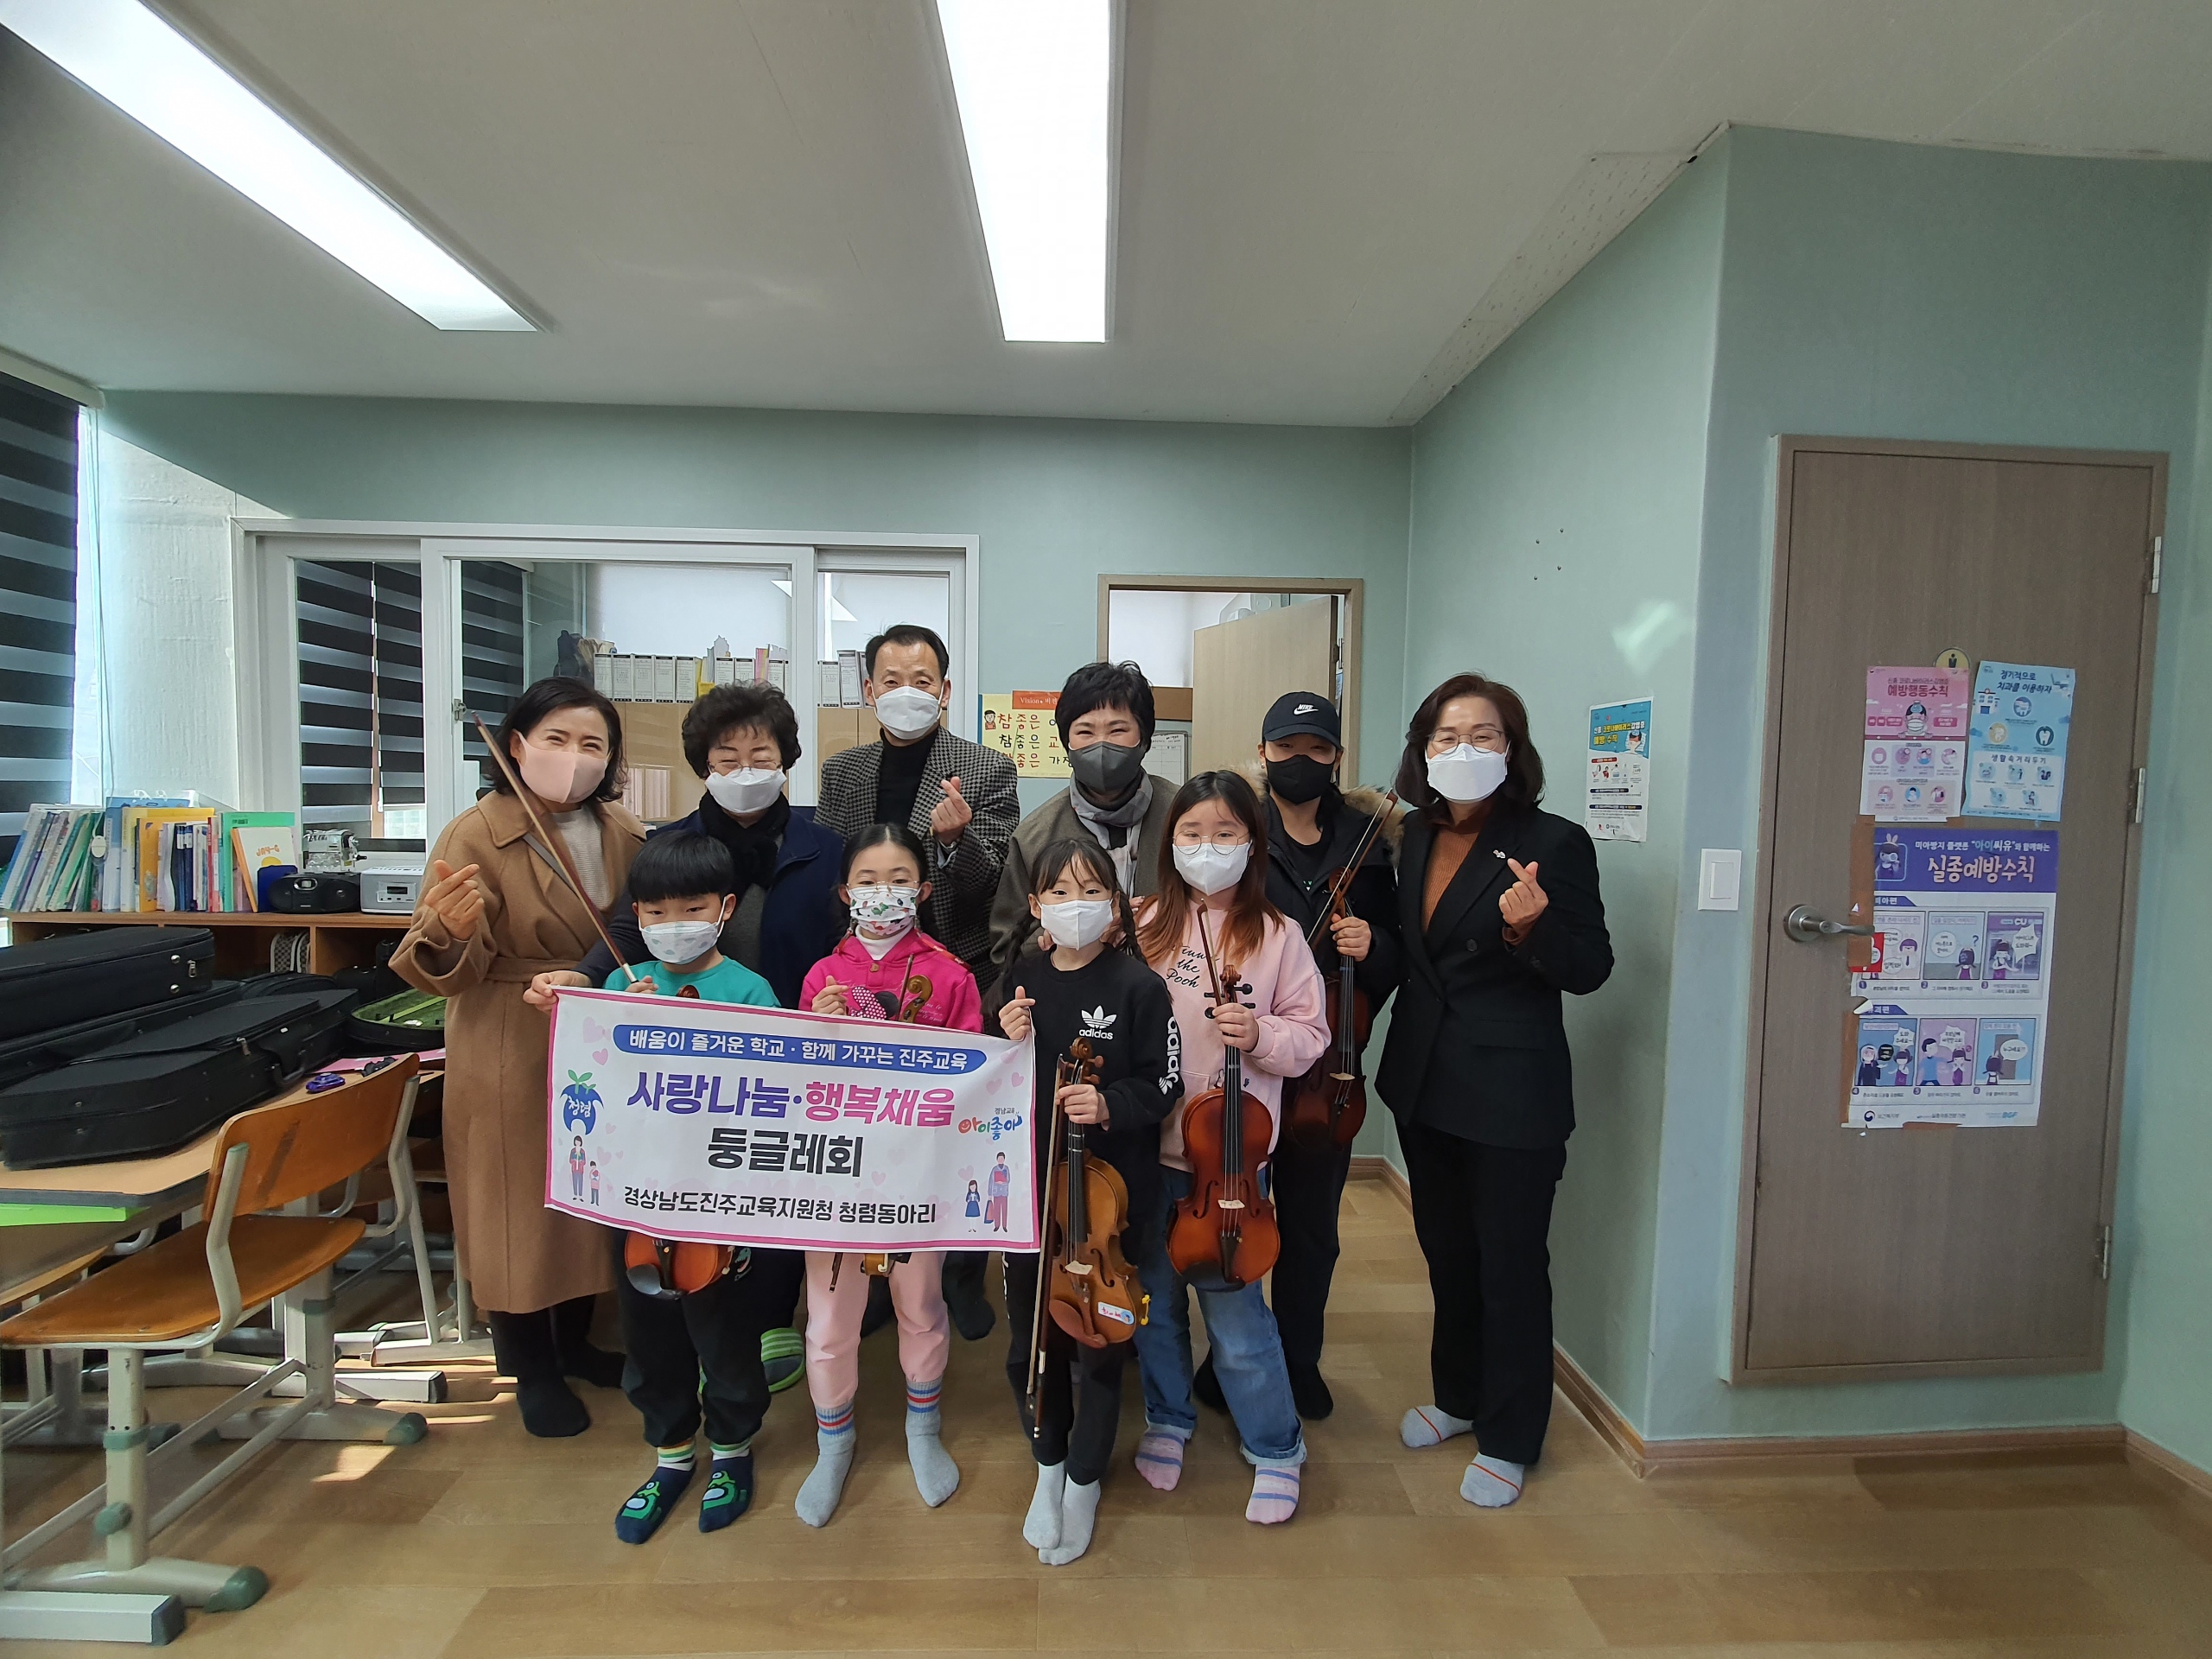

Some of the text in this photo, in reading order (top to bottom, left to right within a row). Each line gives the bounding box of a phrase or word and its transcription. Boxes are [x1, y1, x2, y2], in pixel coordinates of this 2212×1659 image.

[2000, 670, 2036, 680] 정기적으로
[1888, 684, 1948, 697] 예방행동수칙
[1997, 682, 2052, 694] 치과를 이용하자
[997, 713, 1012, 729] 참
[999, 734, 1013, 748] 참
[1929, 855, 2035, 883] 실종예방수칙
[1177, 959, 1200, 973] the
[1166, 968, 1200, 988] Pooh
[1079, 1028, 1114, 1040] adidas
[629, 1029, 968, 1071] 배움이 즐거운 학교 함께 가꾸는 진주교육
[568, 1095, 591, 1117] 청렴
[957, 1115, 1023, 1141] 아이좋아
[707, 1128, 864, 1178] 둥글레회
[624, 1185, 937, 1225] 경상남도진주교육지원청 청렴동아리
